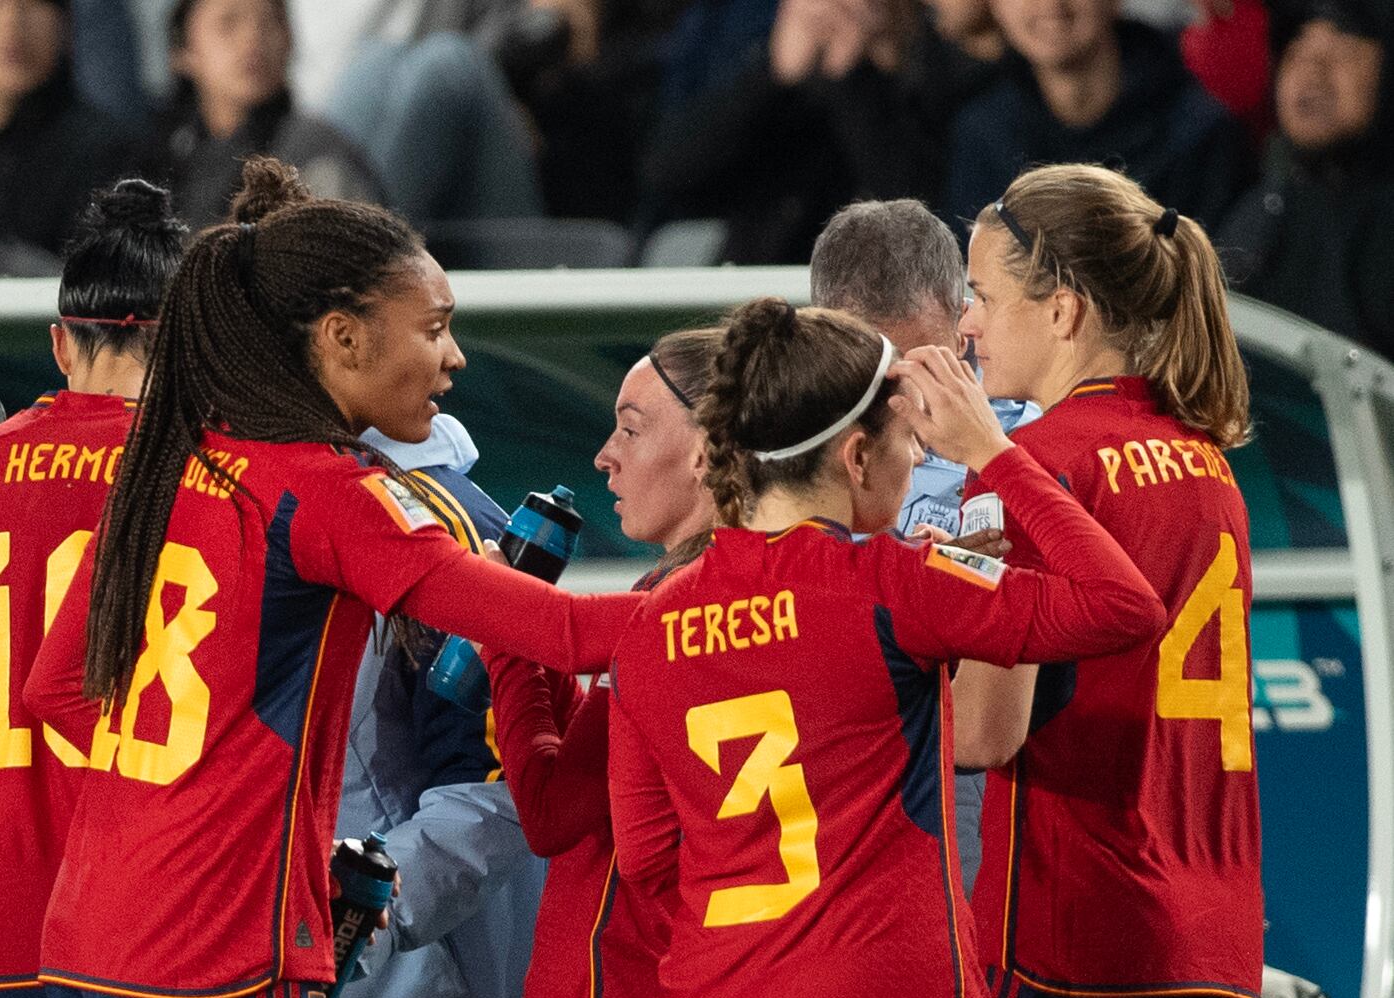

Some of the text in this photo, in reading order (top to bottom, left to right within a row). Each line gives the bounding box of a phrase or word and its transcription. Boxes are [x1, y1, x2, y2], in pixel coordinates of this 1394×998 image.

[661, 590, 799, 662] TERESA
[1157, 532, 1252, 771] 4
[686, 690, 820, 928] 3
